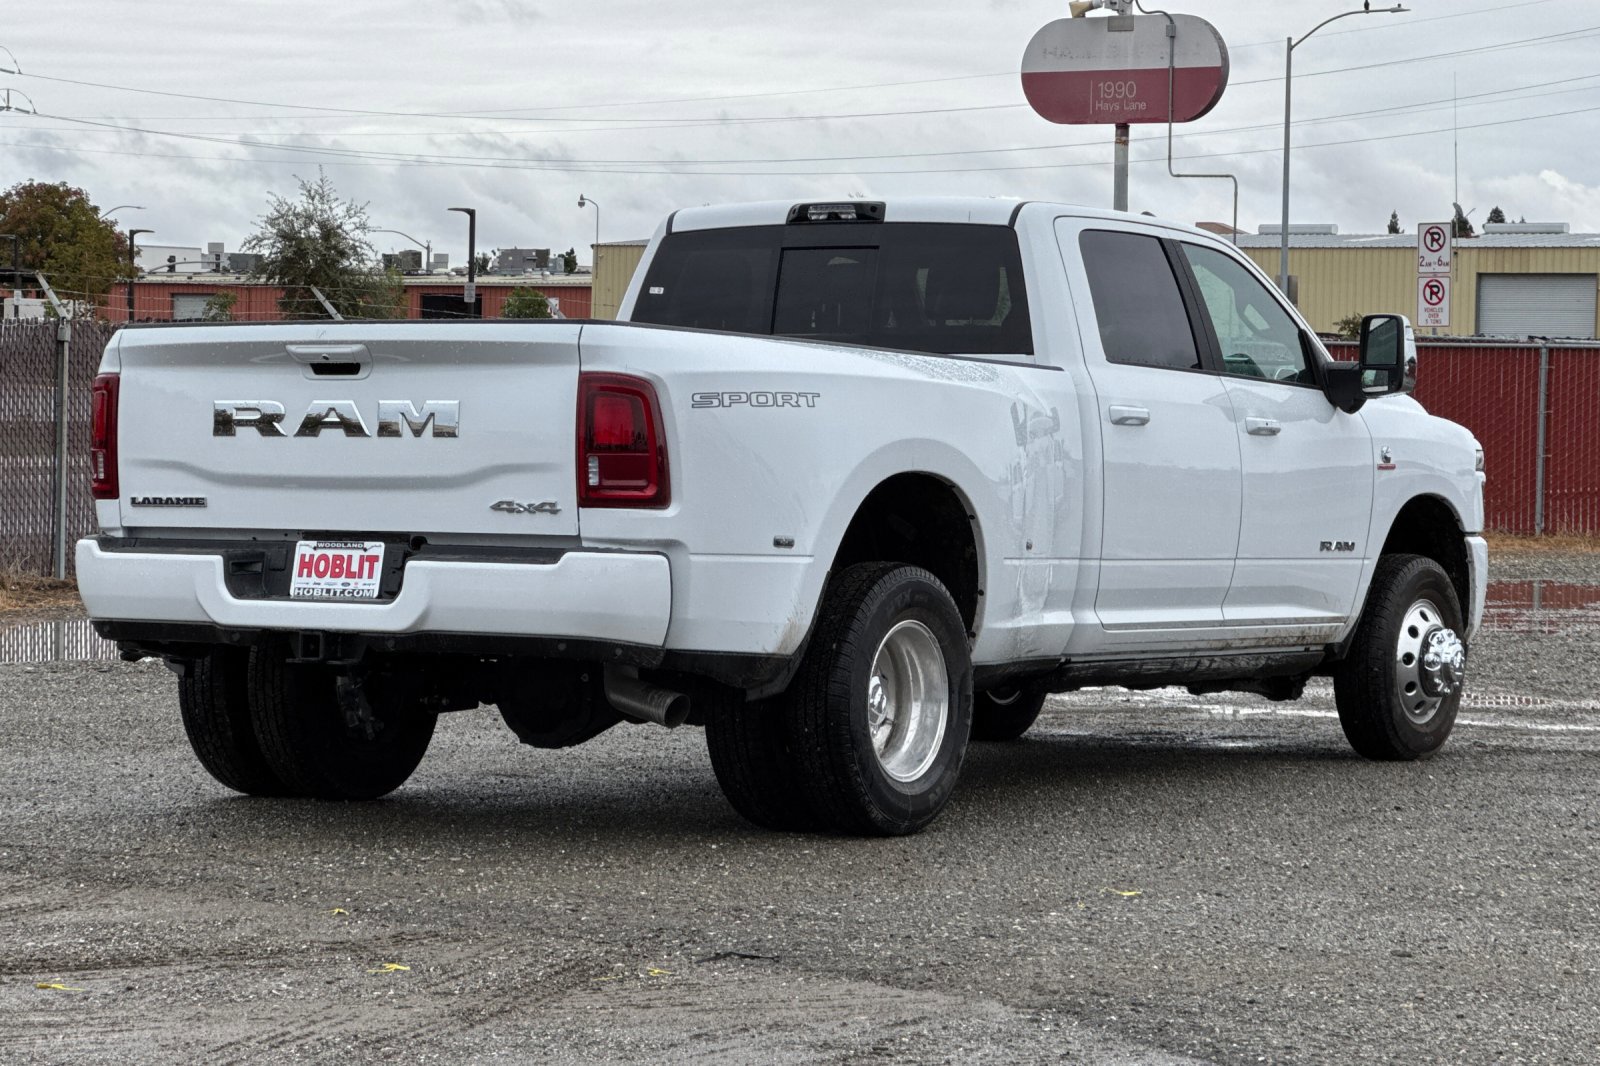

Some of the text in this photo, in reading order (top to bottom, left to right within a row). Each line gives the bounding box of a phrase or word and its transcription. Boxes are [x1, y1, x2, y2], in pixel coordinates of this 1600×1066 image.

[1098, 81, 1137, 98] 1990
[1095, 100, 1147, 111] Hays Lane
[691, 392, 821, 408] SPORT
[213, 400, 460, 437] RAM
[130, 497, 207, 507] LARAMIE
[489, 500, 562, 515] 4x4
[1320, 540, 1356, 552] RAM
[297, 553, 380, 580] HOBLIT
[294, 587, 375, 598] HOBLIT.COM
